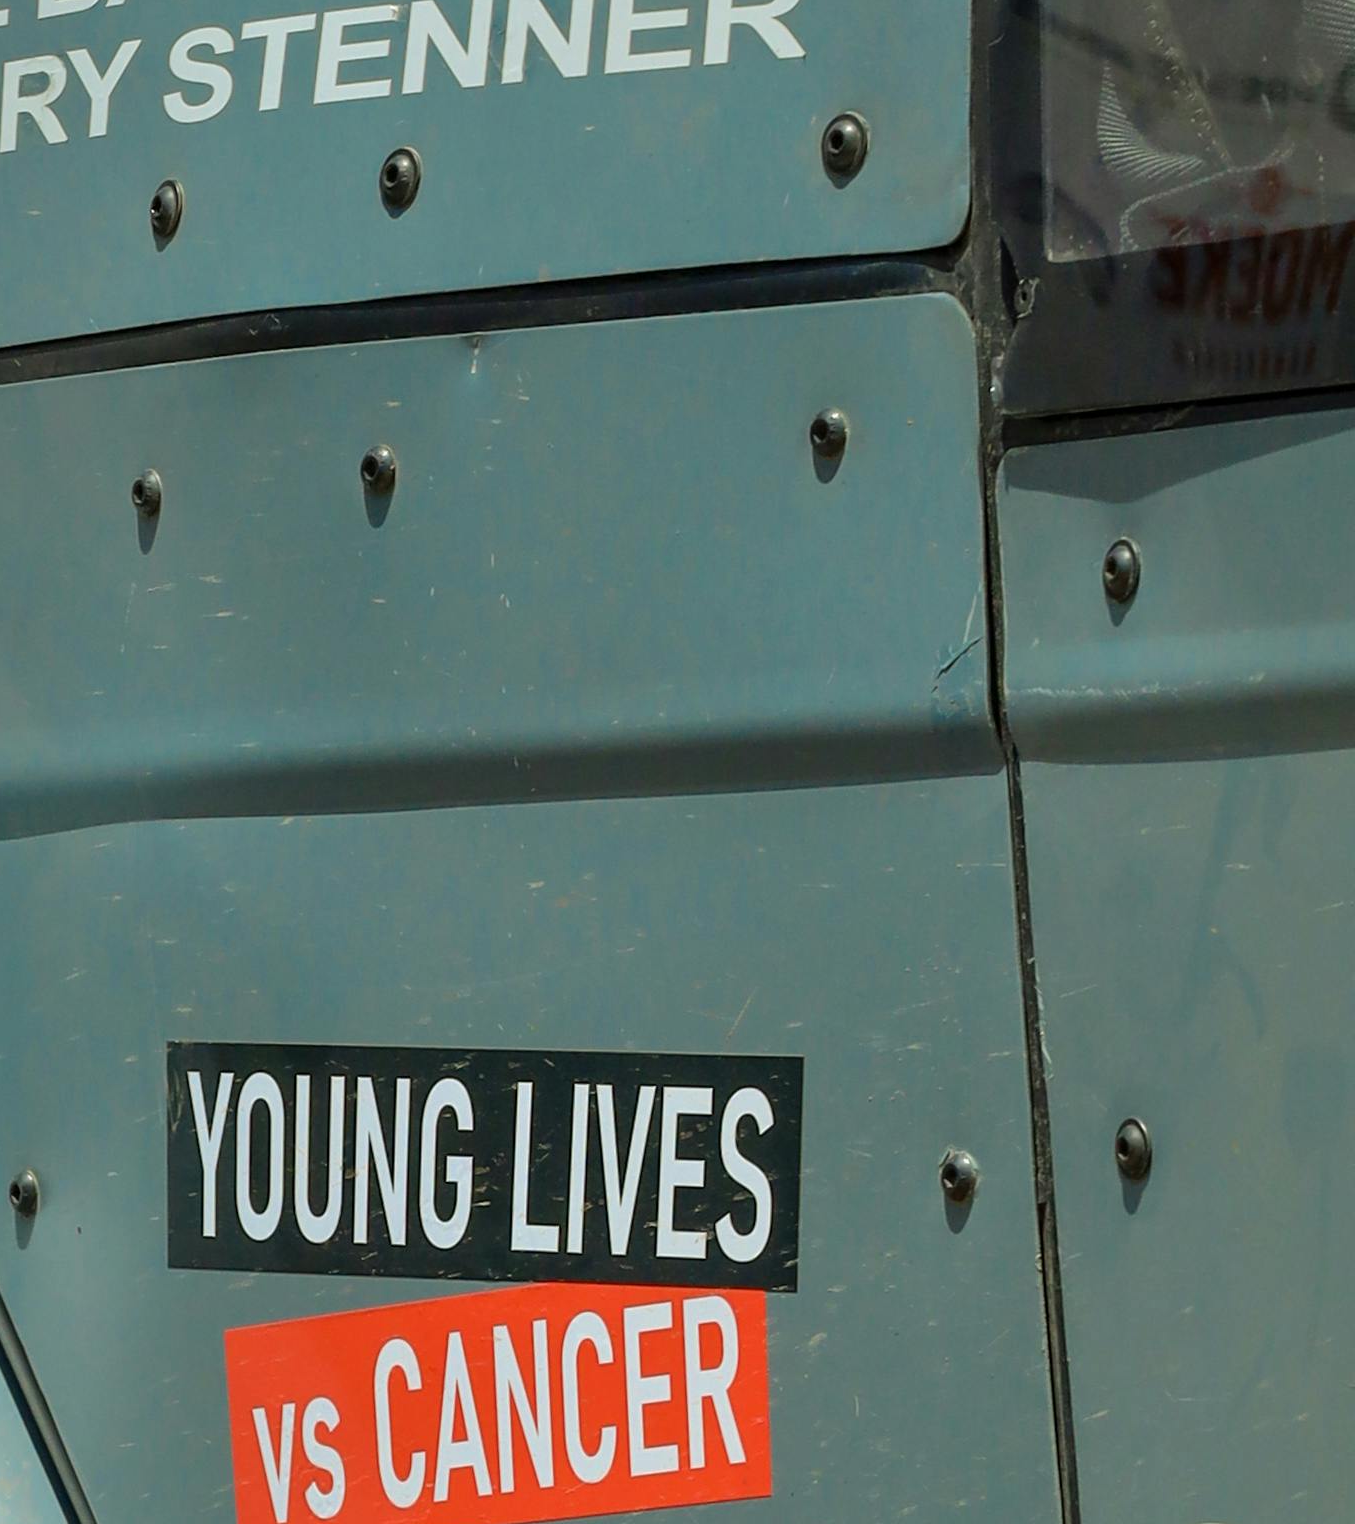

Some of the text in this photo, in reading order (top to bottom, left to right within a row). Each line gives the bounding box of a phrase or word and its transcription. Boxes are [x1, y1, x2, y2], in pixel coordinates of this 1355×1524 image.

[186, 1071, 775, 1264] YOUNG LIVES
[373, 1294, 747, 1510] CANCER
